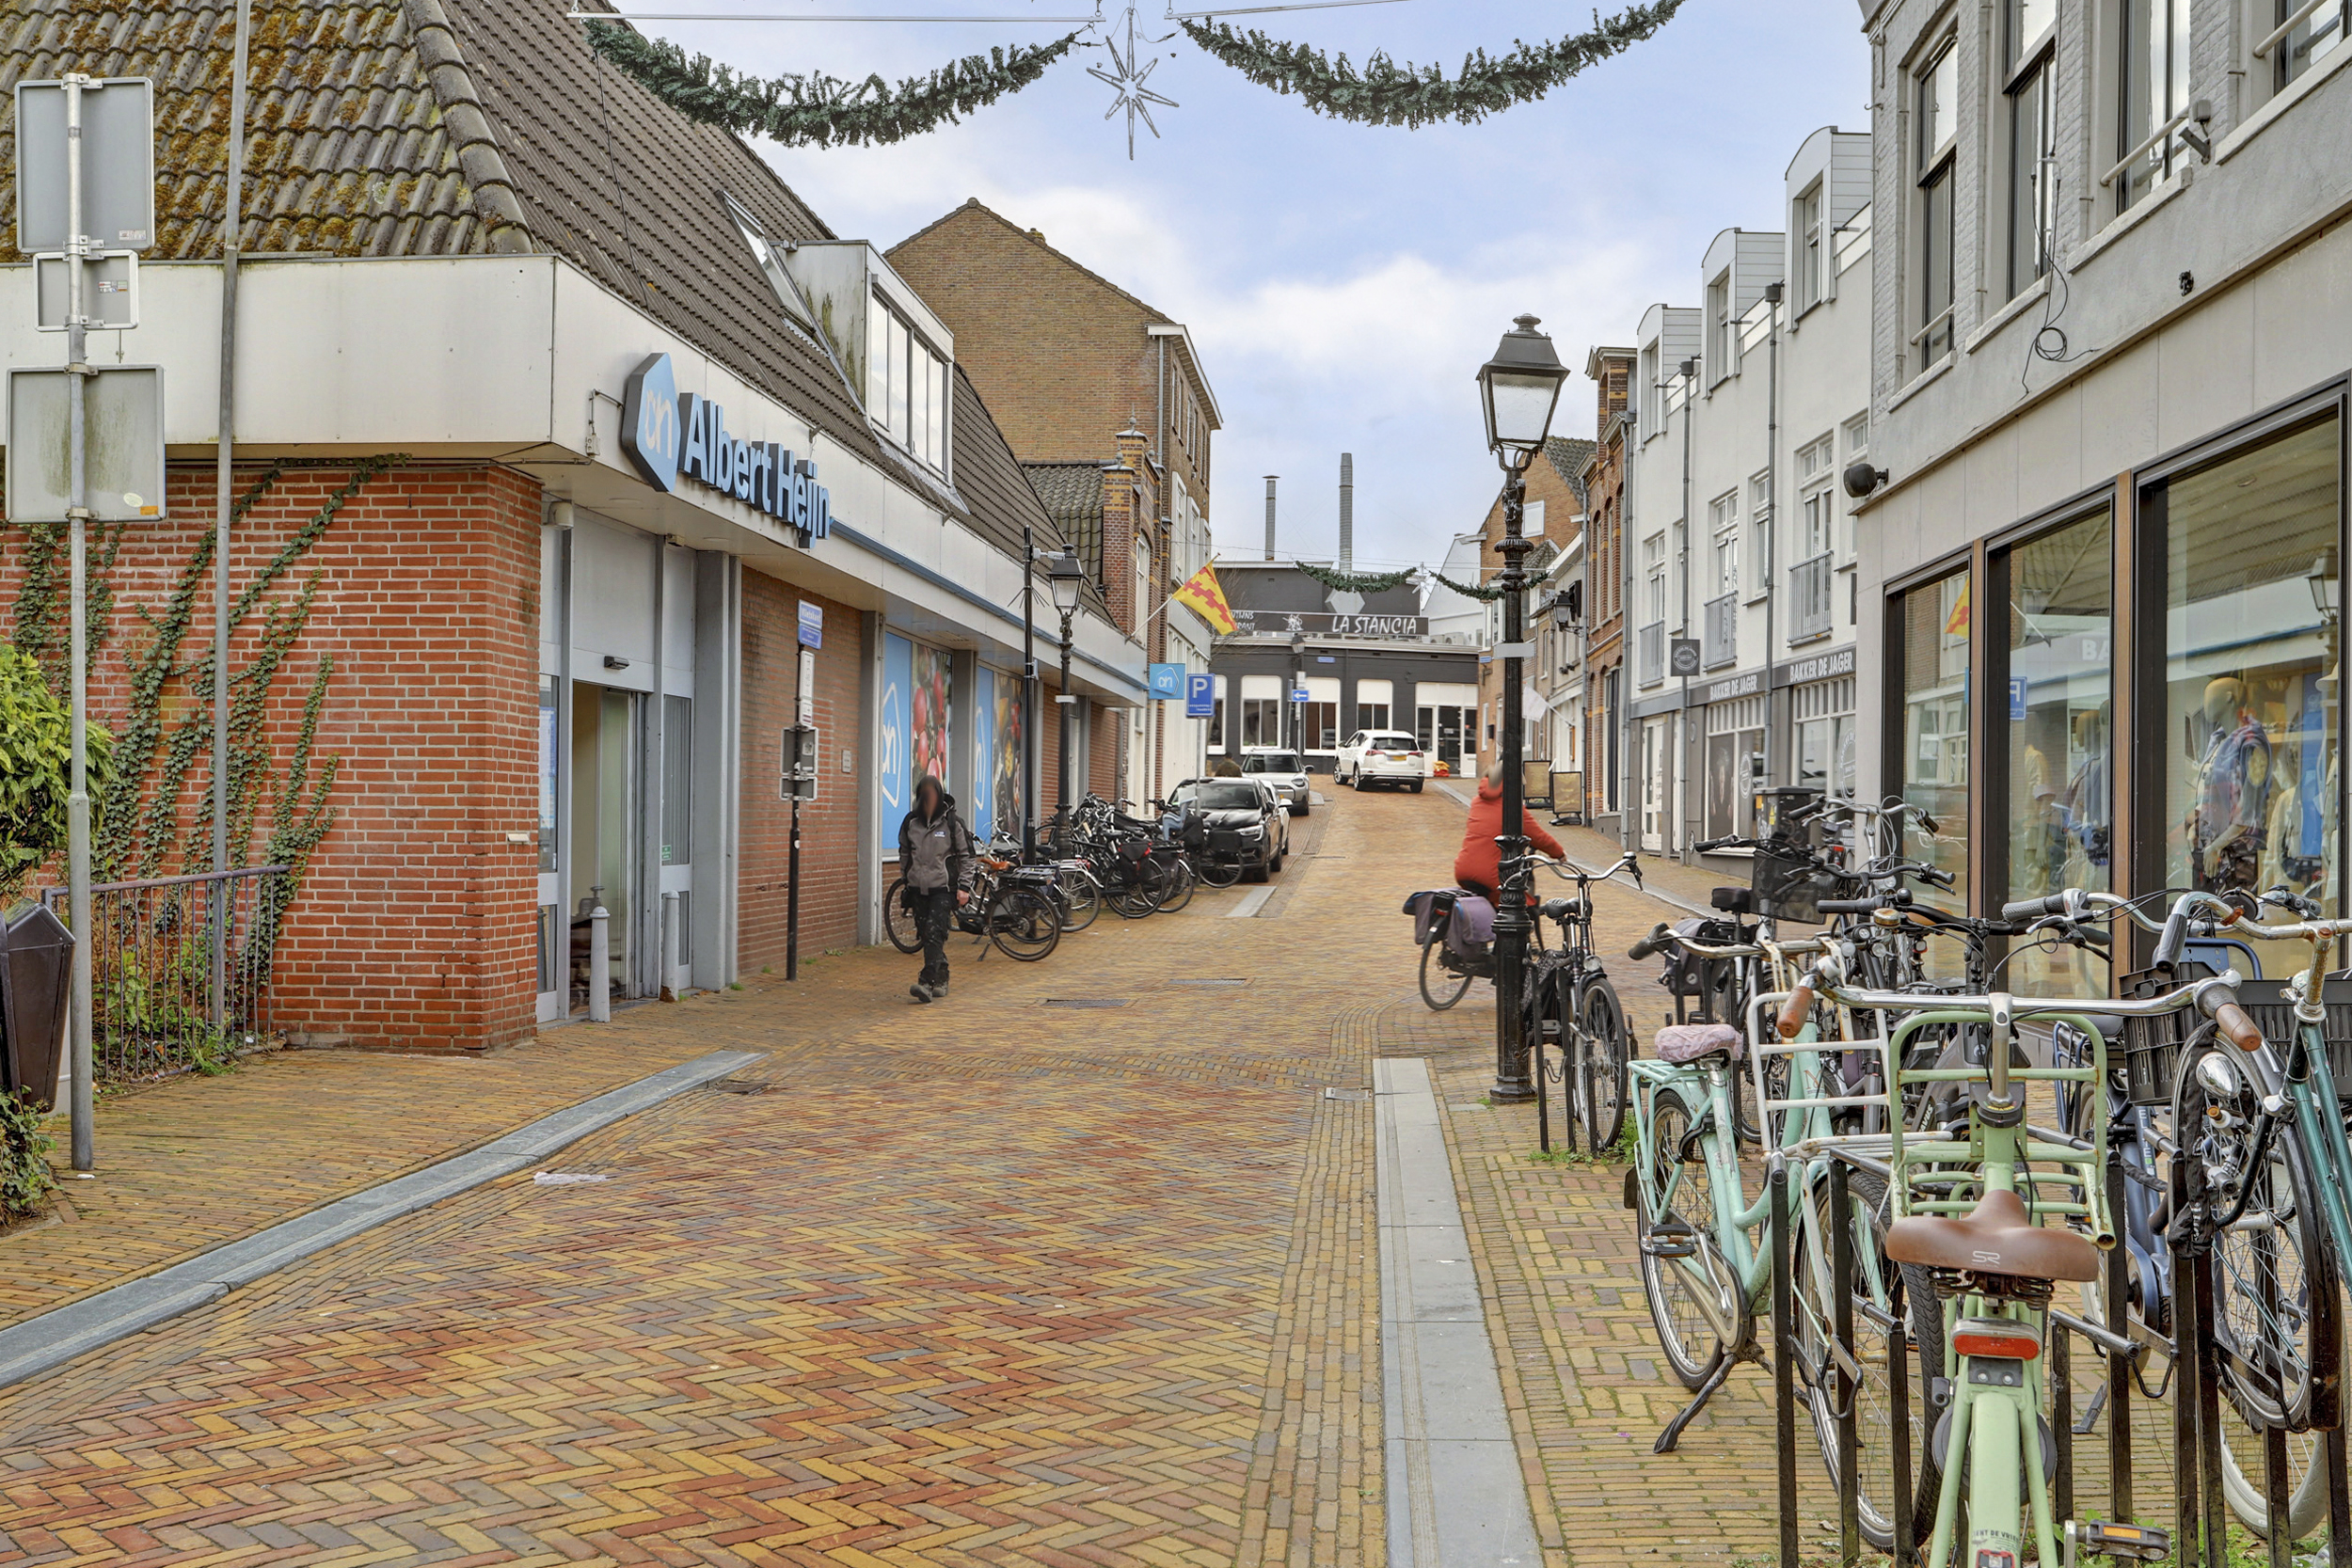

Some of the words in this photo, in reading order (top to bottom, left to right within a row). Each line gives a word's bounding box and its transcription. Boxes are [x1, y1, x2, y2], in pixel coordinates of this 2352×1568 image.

[682, 392, 771, 513] Albert
[775, 443, 830, 548] Heijn
[1332, 615, 1349, 633] LA
[1355, 615, 1417, 634] STANCIA
[1789, 659, 1817, 683] BAKKER
[1818, 657, 1828, 676] DE
[1828, 652, 1852, 674] JAGER
[1192, 677, 1209, 699] P
[1709, 681, 1730, 701] BAKKER
[1731, 679, 1739, 695] DE
[1739, 674, 1757, 694] JAGER
[1919, 1103, 1933, 1132] AVUS
[2138, 1109, 2153, 1158] ELTE
